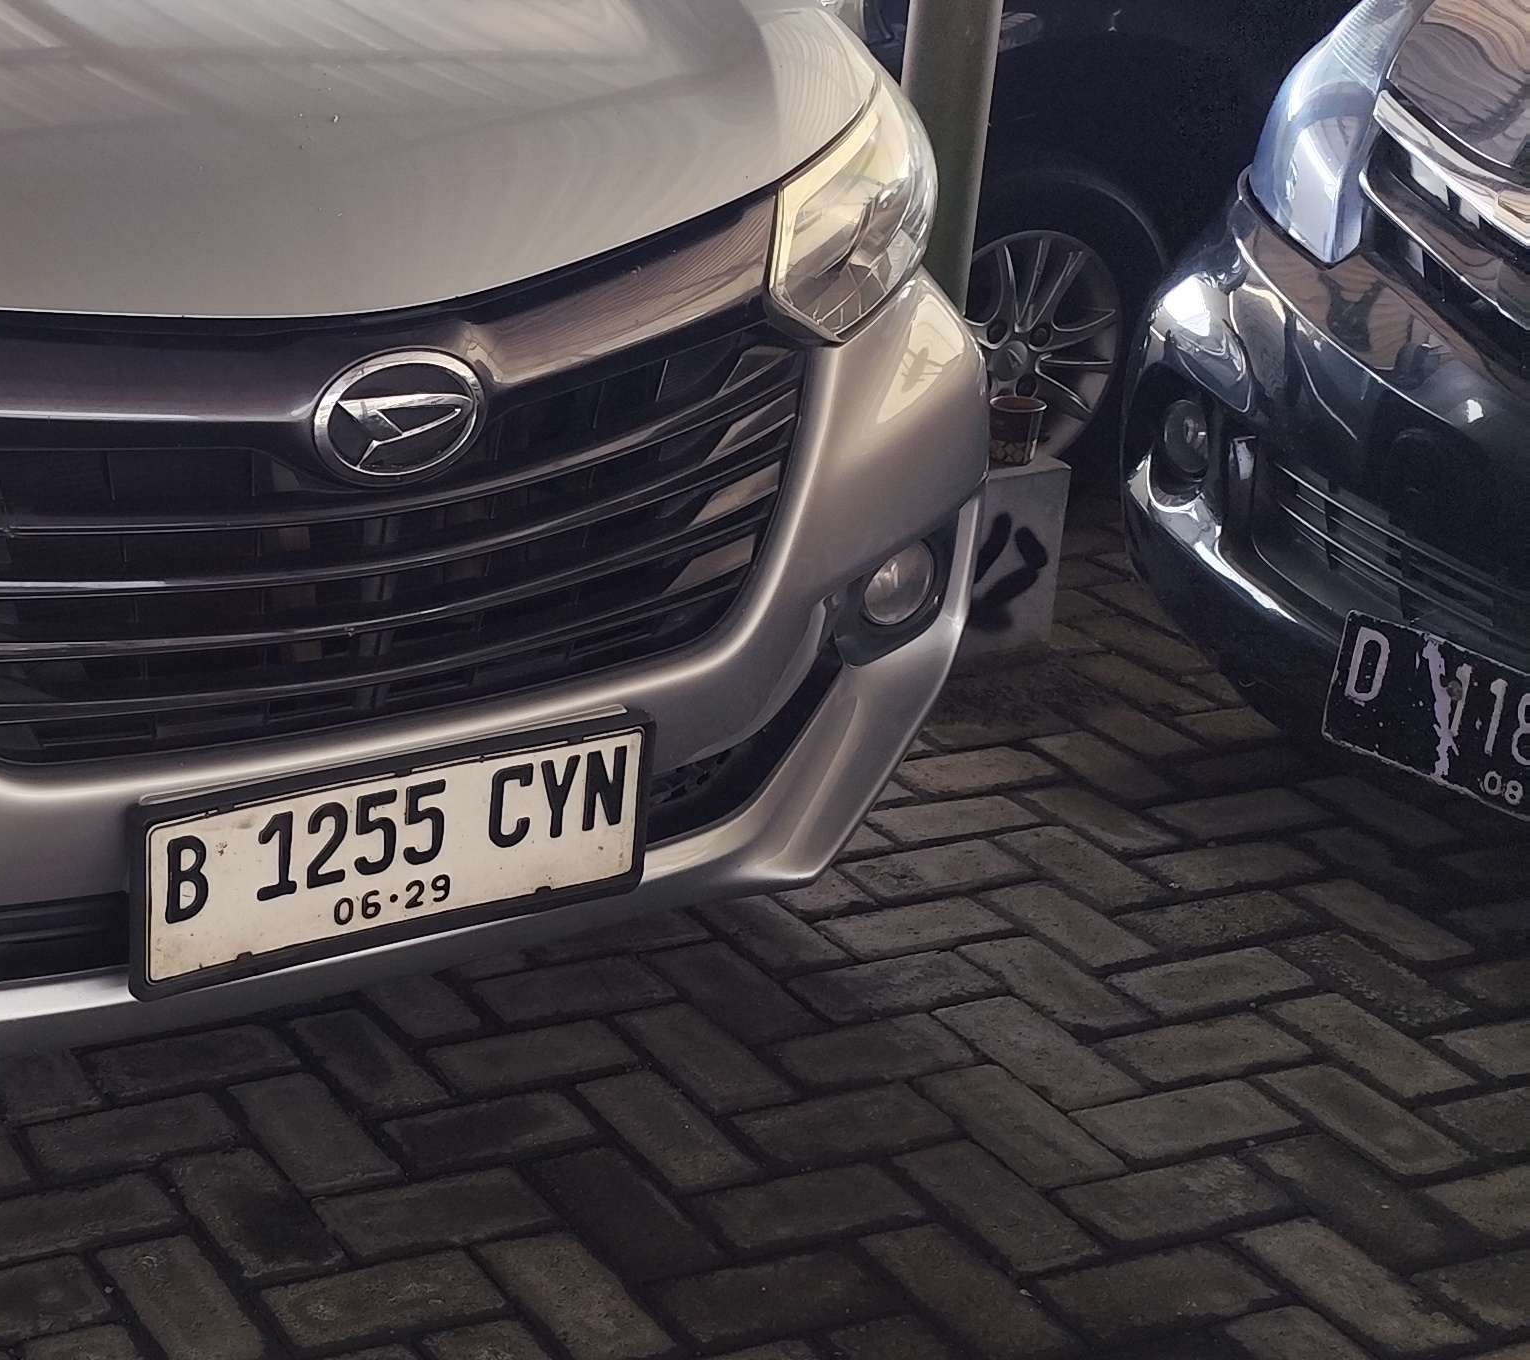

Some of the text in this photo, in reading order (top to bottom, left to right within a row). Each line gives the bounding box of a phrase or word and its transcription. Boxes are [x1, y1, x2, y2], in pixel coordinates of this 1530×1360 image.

[1344, 626, 1390, 702] D
[165, 744, 628, 925] B 1255 CYN
